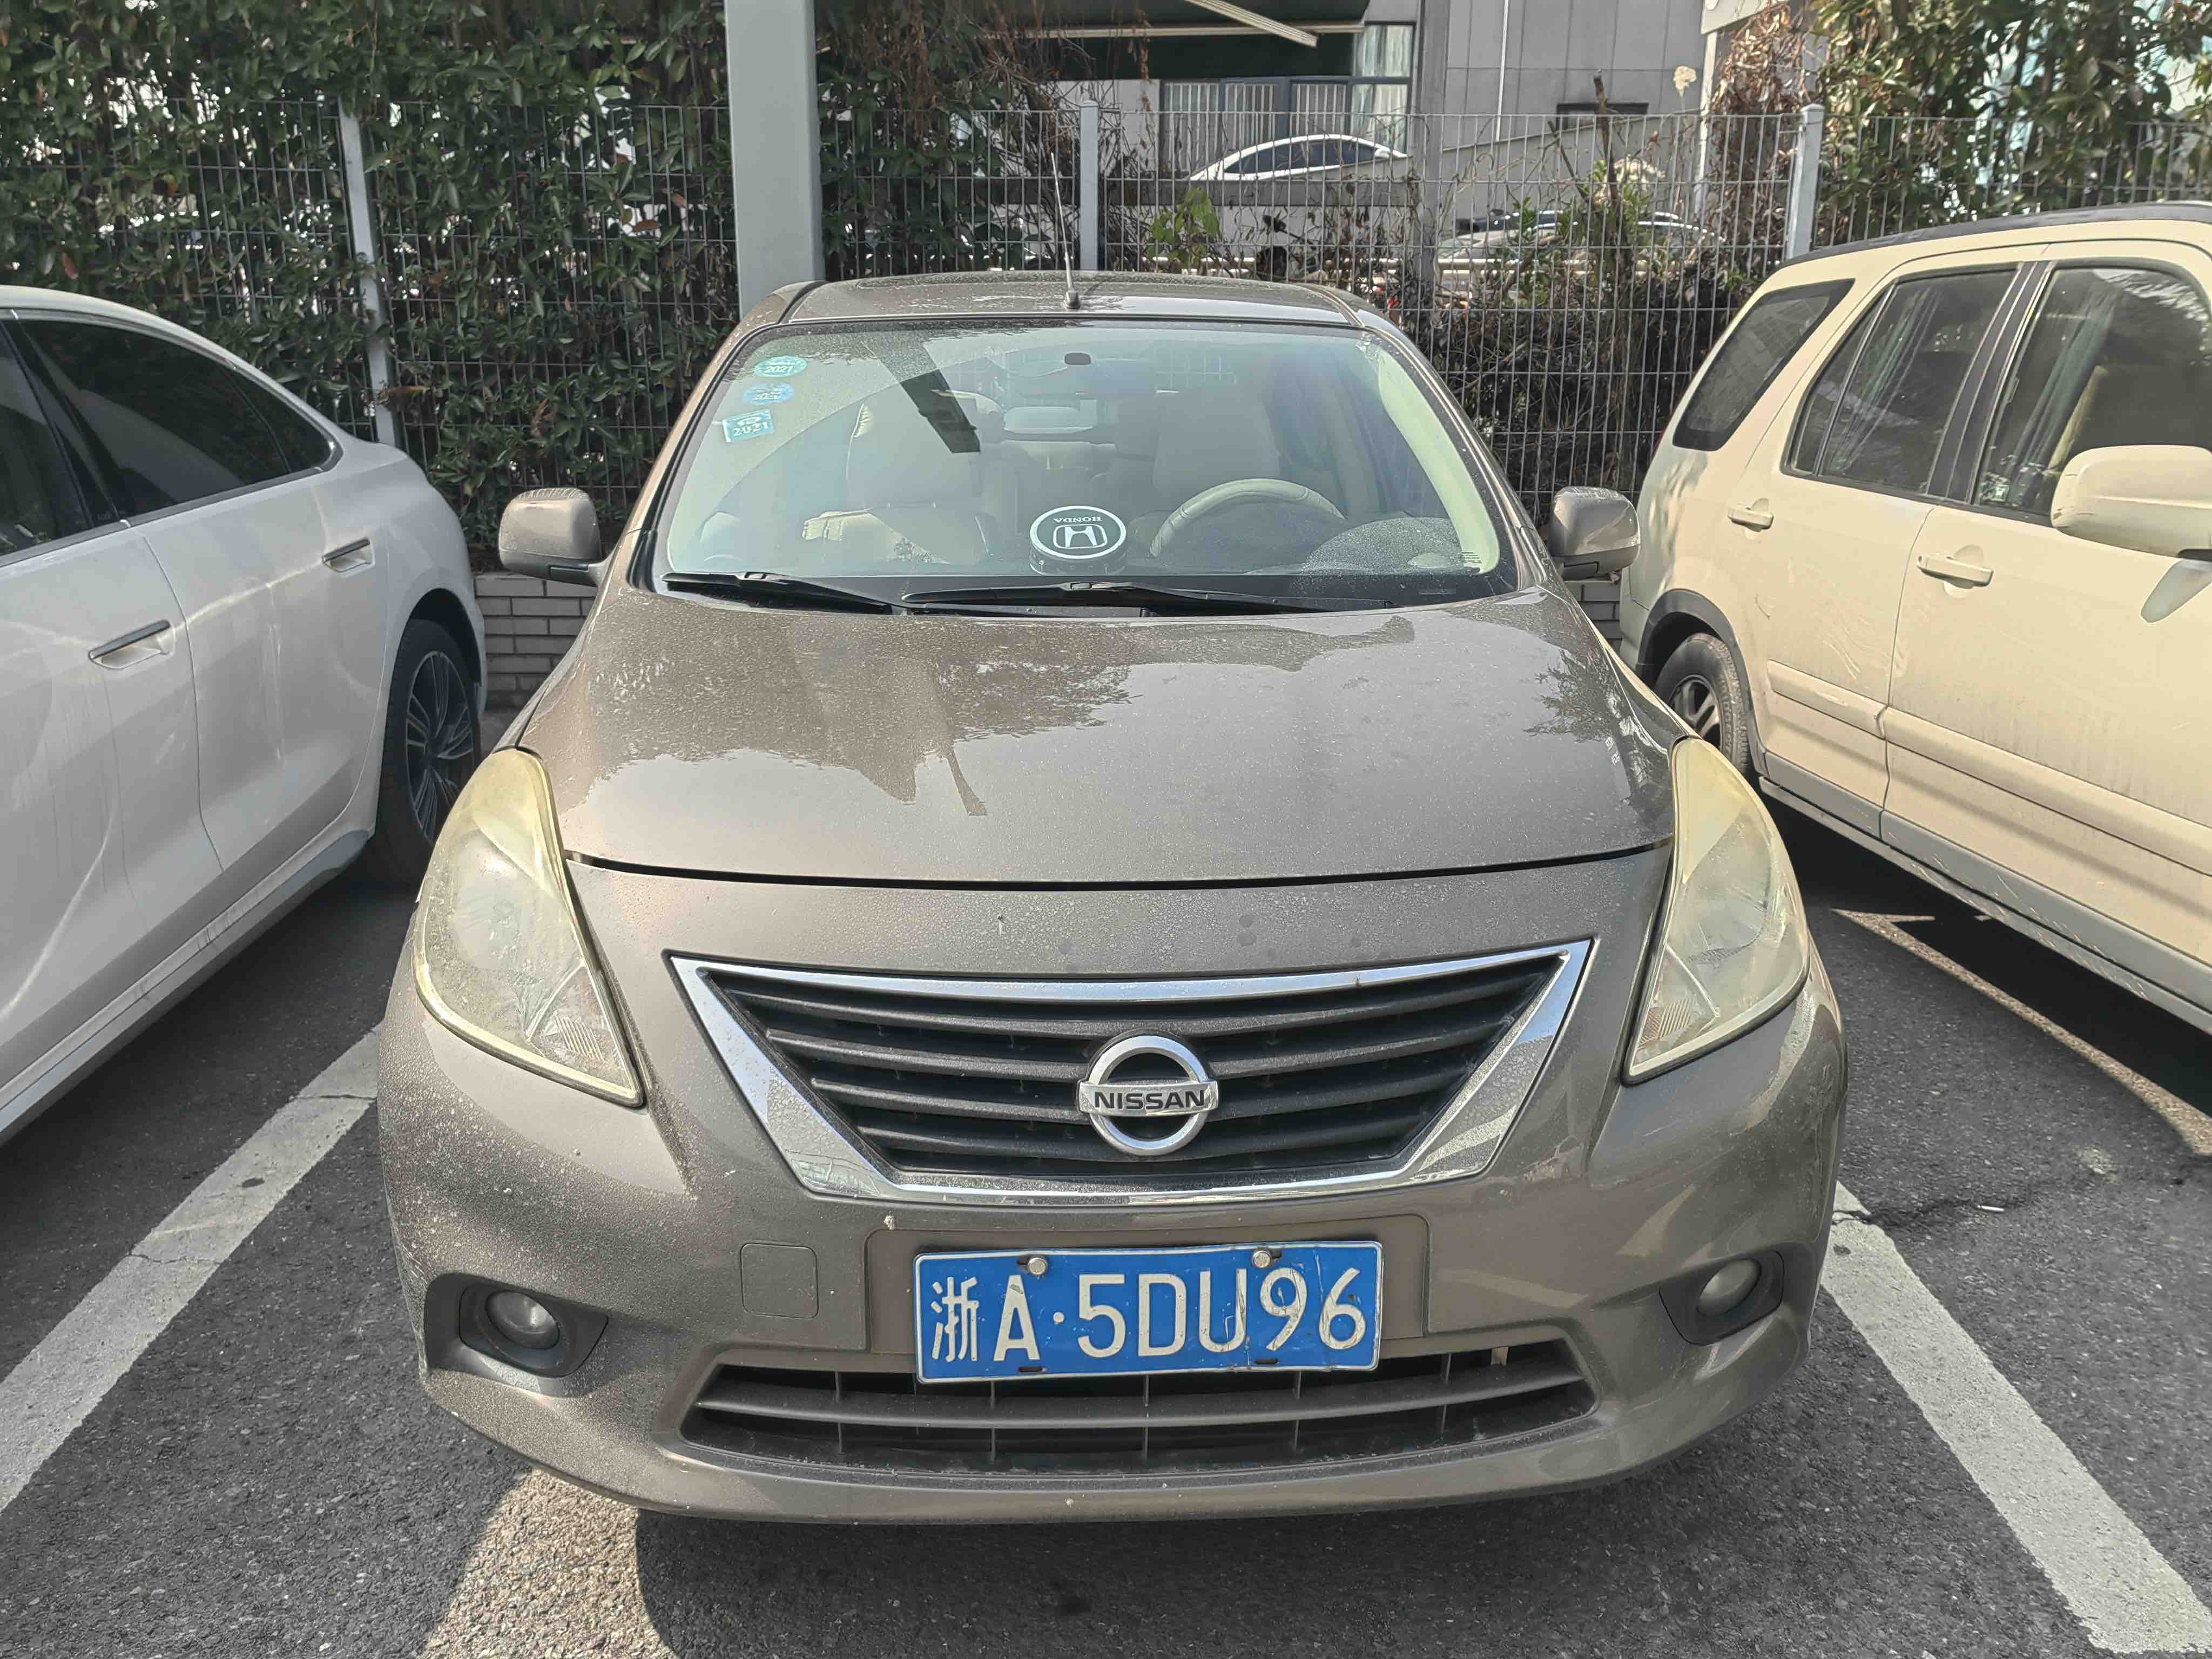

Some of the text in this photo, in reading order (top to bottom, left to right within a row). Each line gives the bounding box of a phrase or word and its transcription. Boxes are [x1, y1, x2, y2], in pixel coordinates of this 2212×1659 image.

[764, 365, 794, 373] 2021
[732, 421, 770, 437] 2021
[1094, 1089, 1204, 1110] NISSAN
